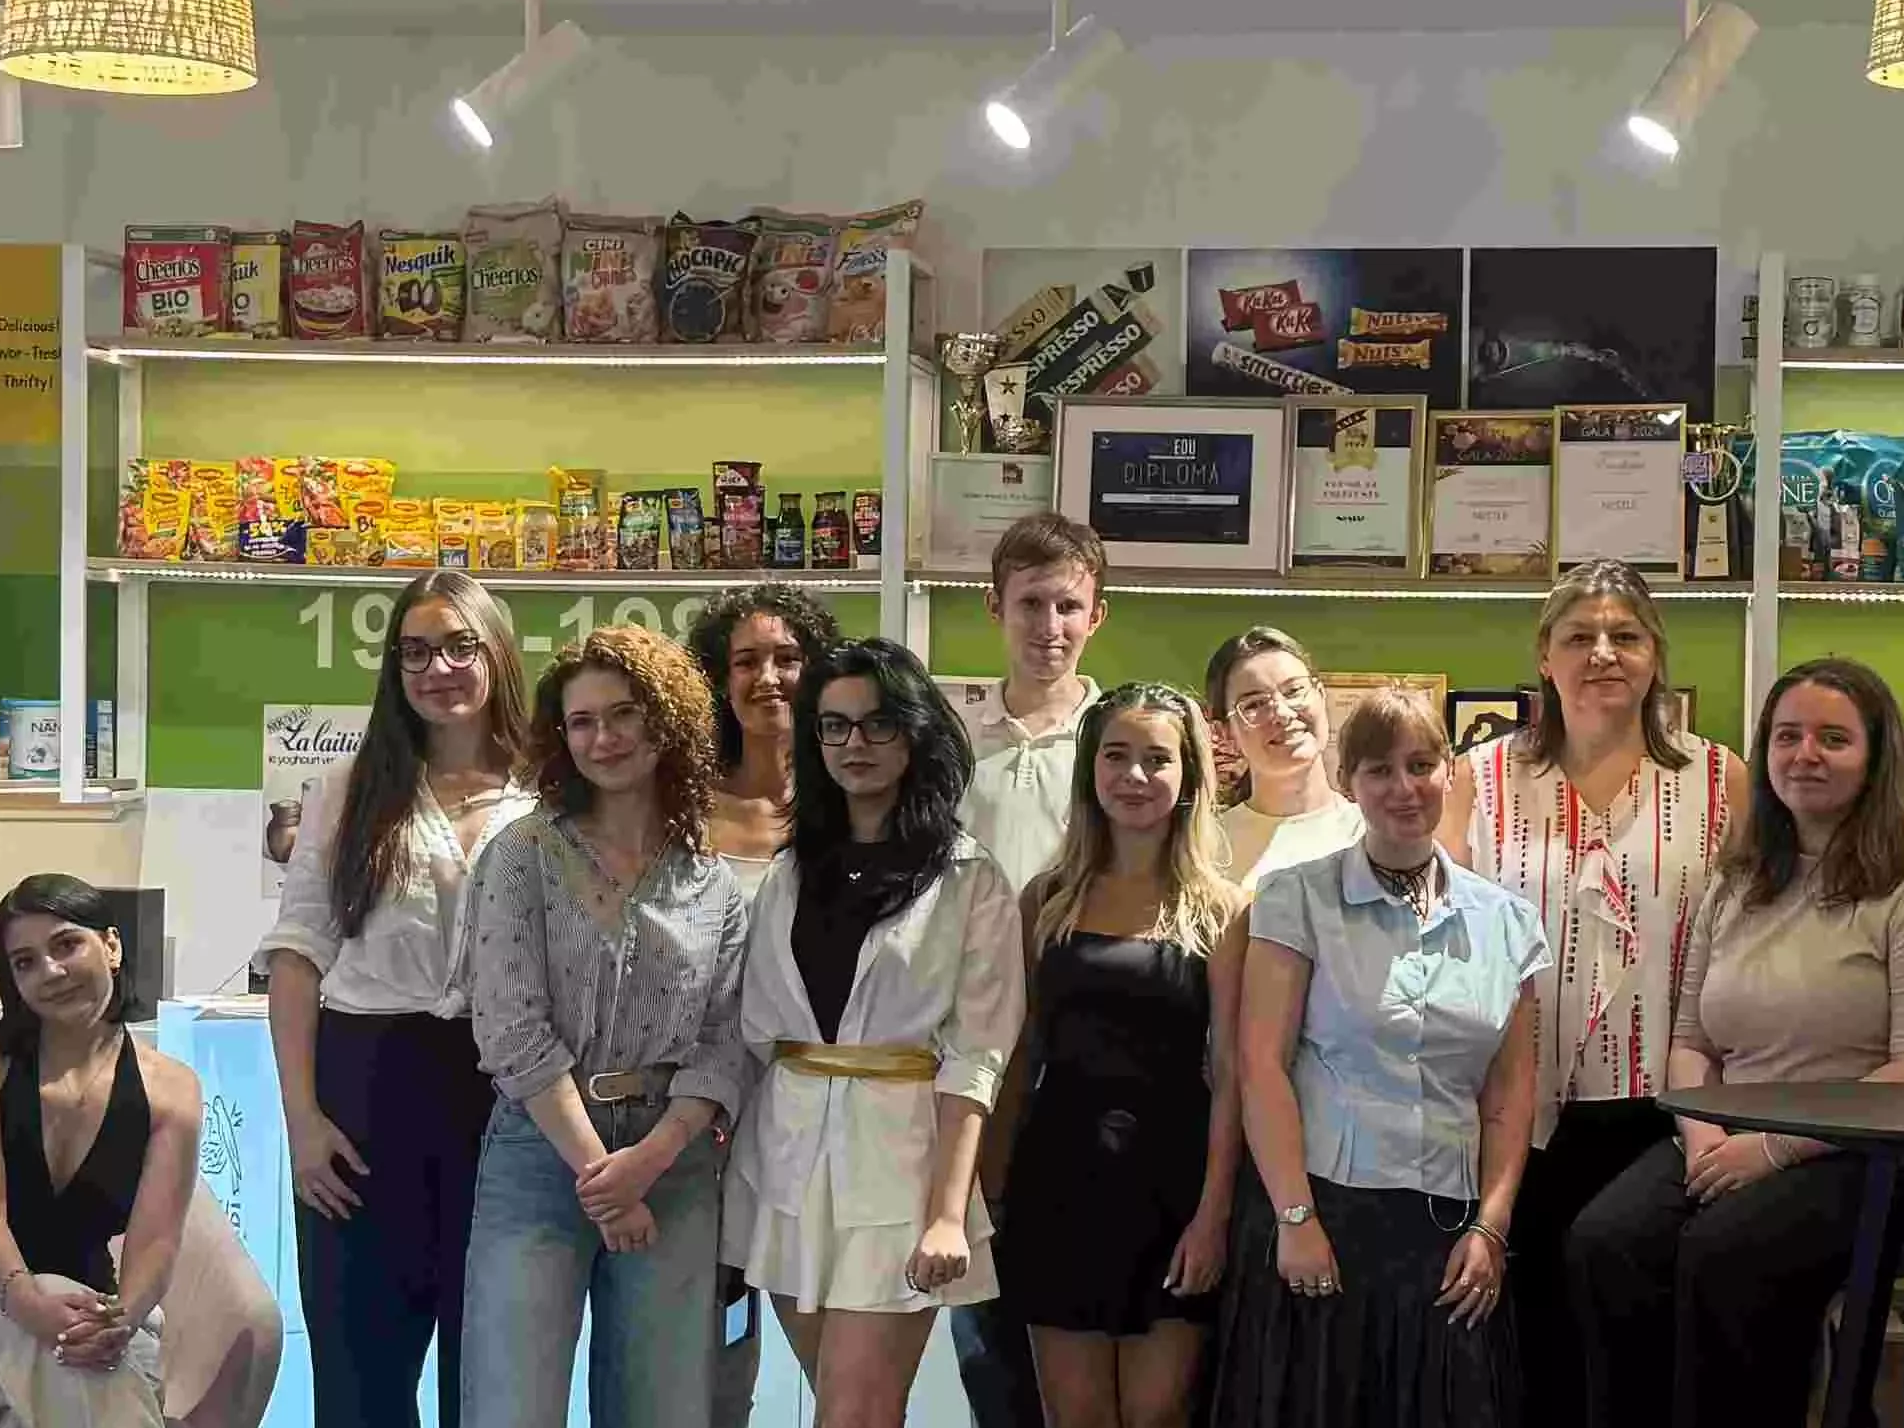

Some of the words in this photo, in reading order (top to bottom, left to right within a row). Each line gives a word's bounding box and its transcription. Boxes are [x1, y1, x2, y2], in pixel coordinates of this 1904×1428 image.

[136, 259, 200, 283] Cheerios
[384, 246, 457, 276] Nesquik
[470, 267, 538, 290] Cheerios
[152, 290, 189, 310] BIO
[4, 373, 54, 394] Thrifty!
[1123, 461, 1220, 486] DIPLOMA
[312, 719, 367, 752] laiti
